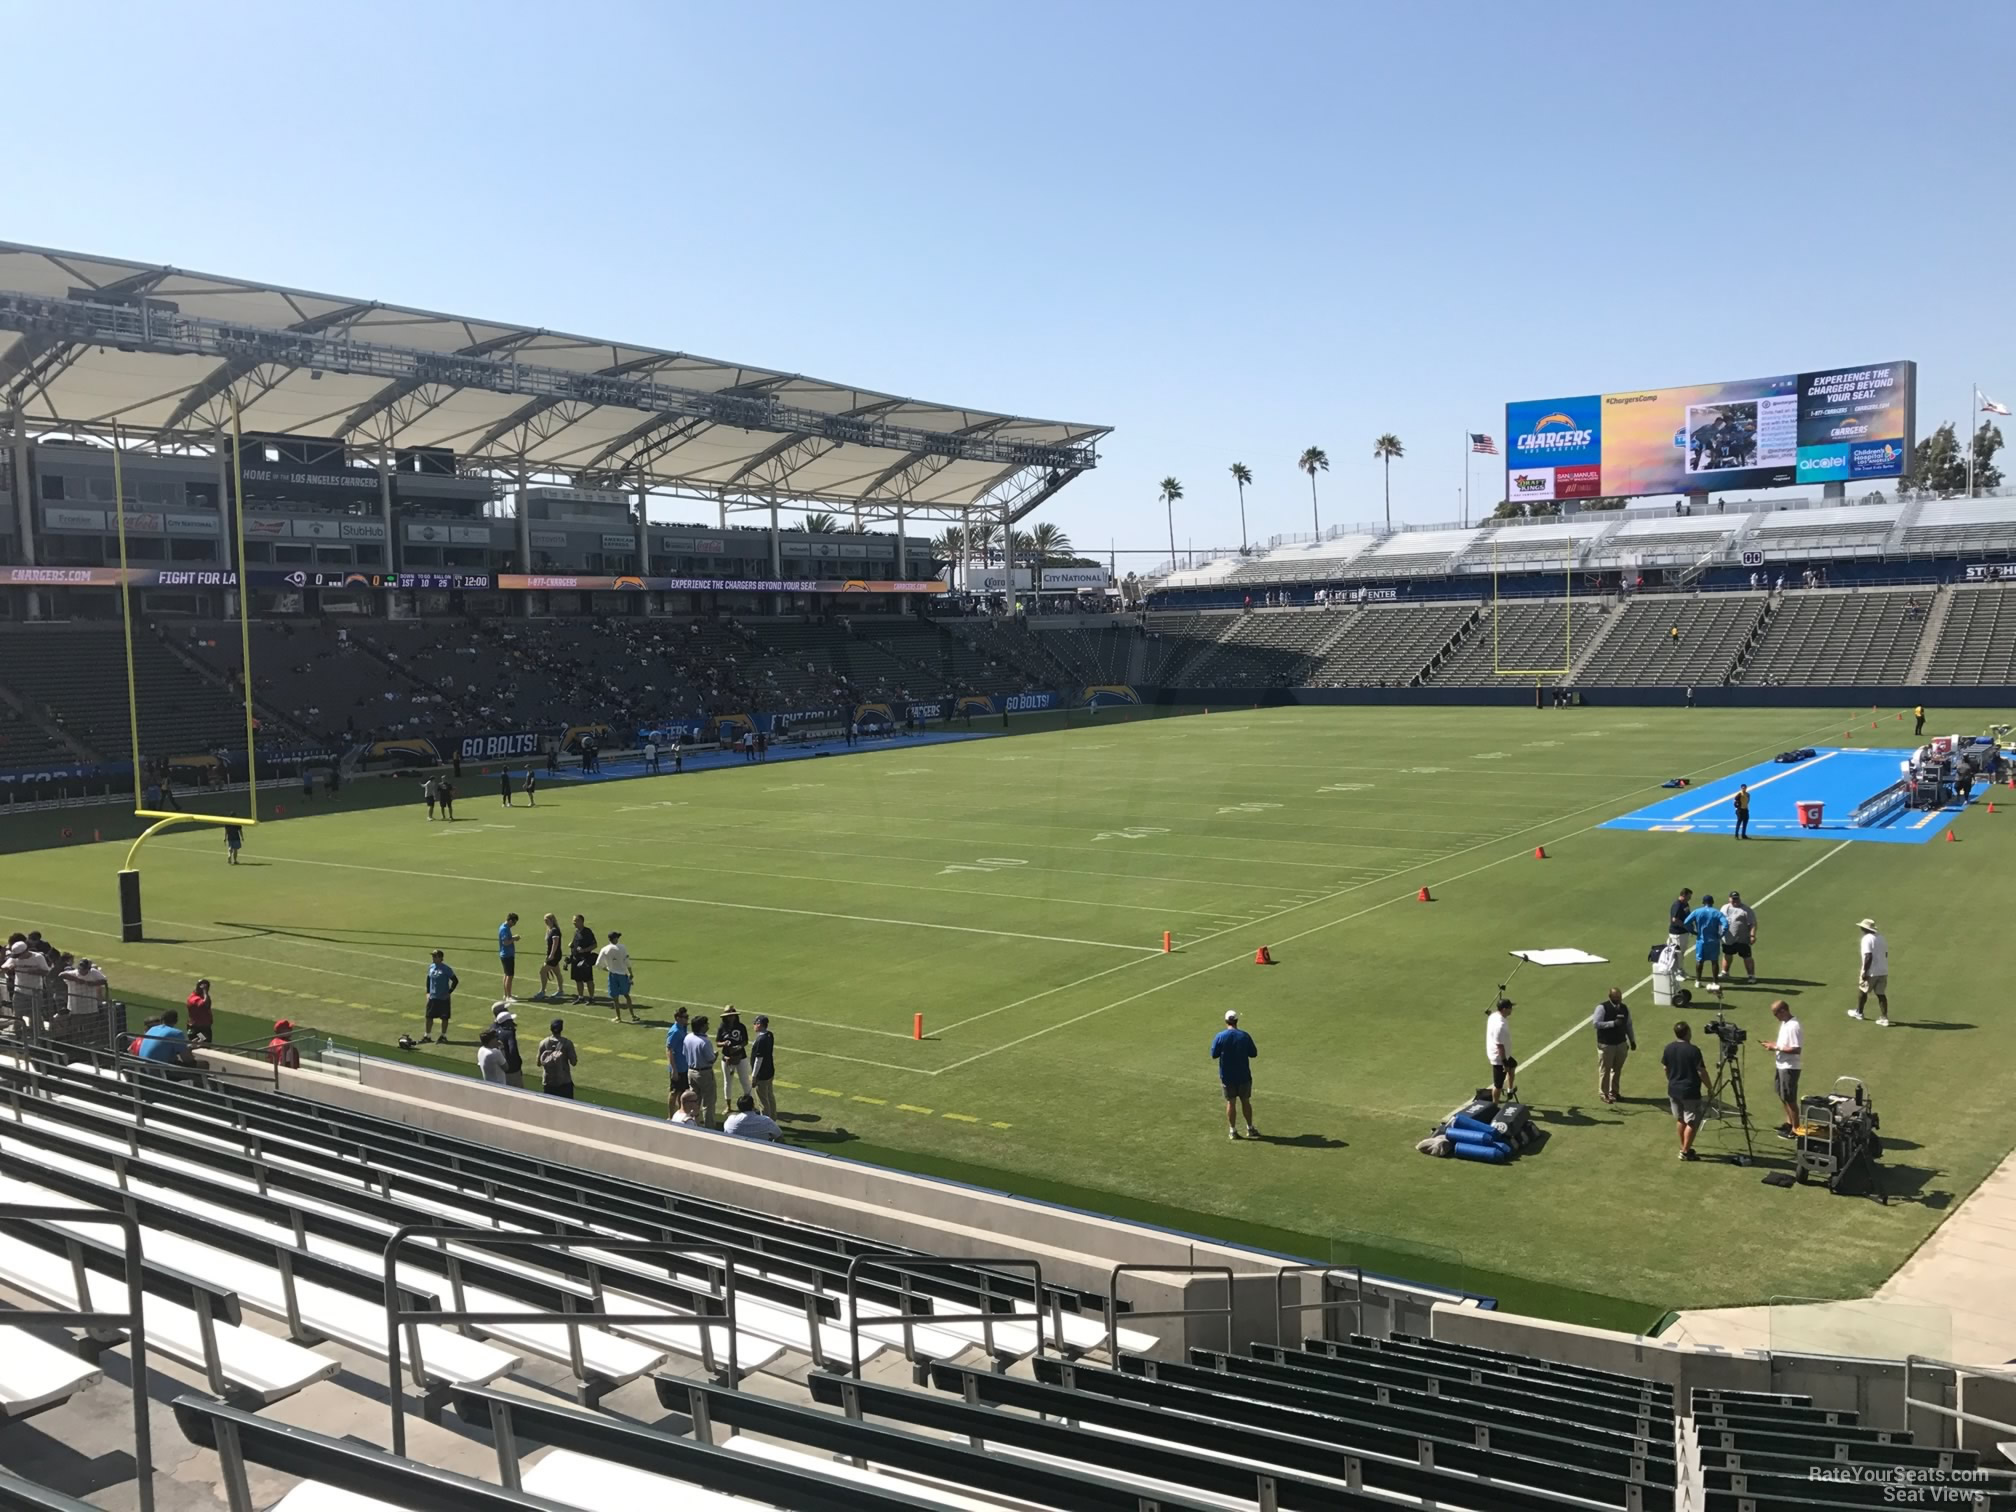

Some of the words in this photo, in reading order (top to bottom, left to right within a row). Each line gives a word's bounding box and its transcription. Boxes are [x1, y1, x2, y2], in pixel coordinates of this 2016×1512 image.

[1814, 371, 1871, 386] EXPERIENCE
[1872, 369, 1890, 378] THE
[1808, 382, 1855, 396] CHARGERS
[1857, 378, 1893, 391] BEYOND
[1826, 391, 1850, 403] YOUR
[1852, 389, 1876, 400] SEAT.
[1830, 425, 1868, 437] CHARGERS
[1517, 429, 1593, 450] CHARGERS
[1853, 448, 1884, 456] Children's
[1854, 453, 1884, 462] Hospital
[1800, 456, 1846, 470] alcatel
[243, 469, 272, 481] HOME
[291, 473, 306, 483] LOS
[306, 474, 340, 486] ANGELES
[341, 476, 379, 488] CHARGERS
[343, 525, 384, 537] StubHub
[11, 569, 92, 582] CHARGERS.COM
[158, 571, 196, 584] FIGHT
[197, 572, 220, 585] FOR
[222, 572, 237, 585] LA
[315, 574, 323, 585] 0
[372, 575, 380, 586] 0
[1043, 574, 1060, 583] CITY
[1061, 574, 1102, 583] NATIONAL
[402, 579, 414, 587] 1ST
[421, 579, 429, 587] 10
[438, 579, 447, 588] 25
[464, 576, 487, 587] 12:00
[671, 579, 711, 589] EXPERIENCE
[712, 580, 724, 589] THE
[724, 580, 757, 590] CHARGERS
[757, 581, 782, 590] BEYOND
[783, 581, 800, 590] YOUR
[800, 582, 817, 590] SEAT.
[984, 580, 1015, 588] Coroa
[1006, 697, 1018, 710] GO
[1020, 695, 1050, 709] BOLTS!
[462, 738, 484, 757] GO
[487, 734, 538, 755] BOLTS!
[1808, 808, 1819, 819] G
[945, 857, 1029, 873] 10
